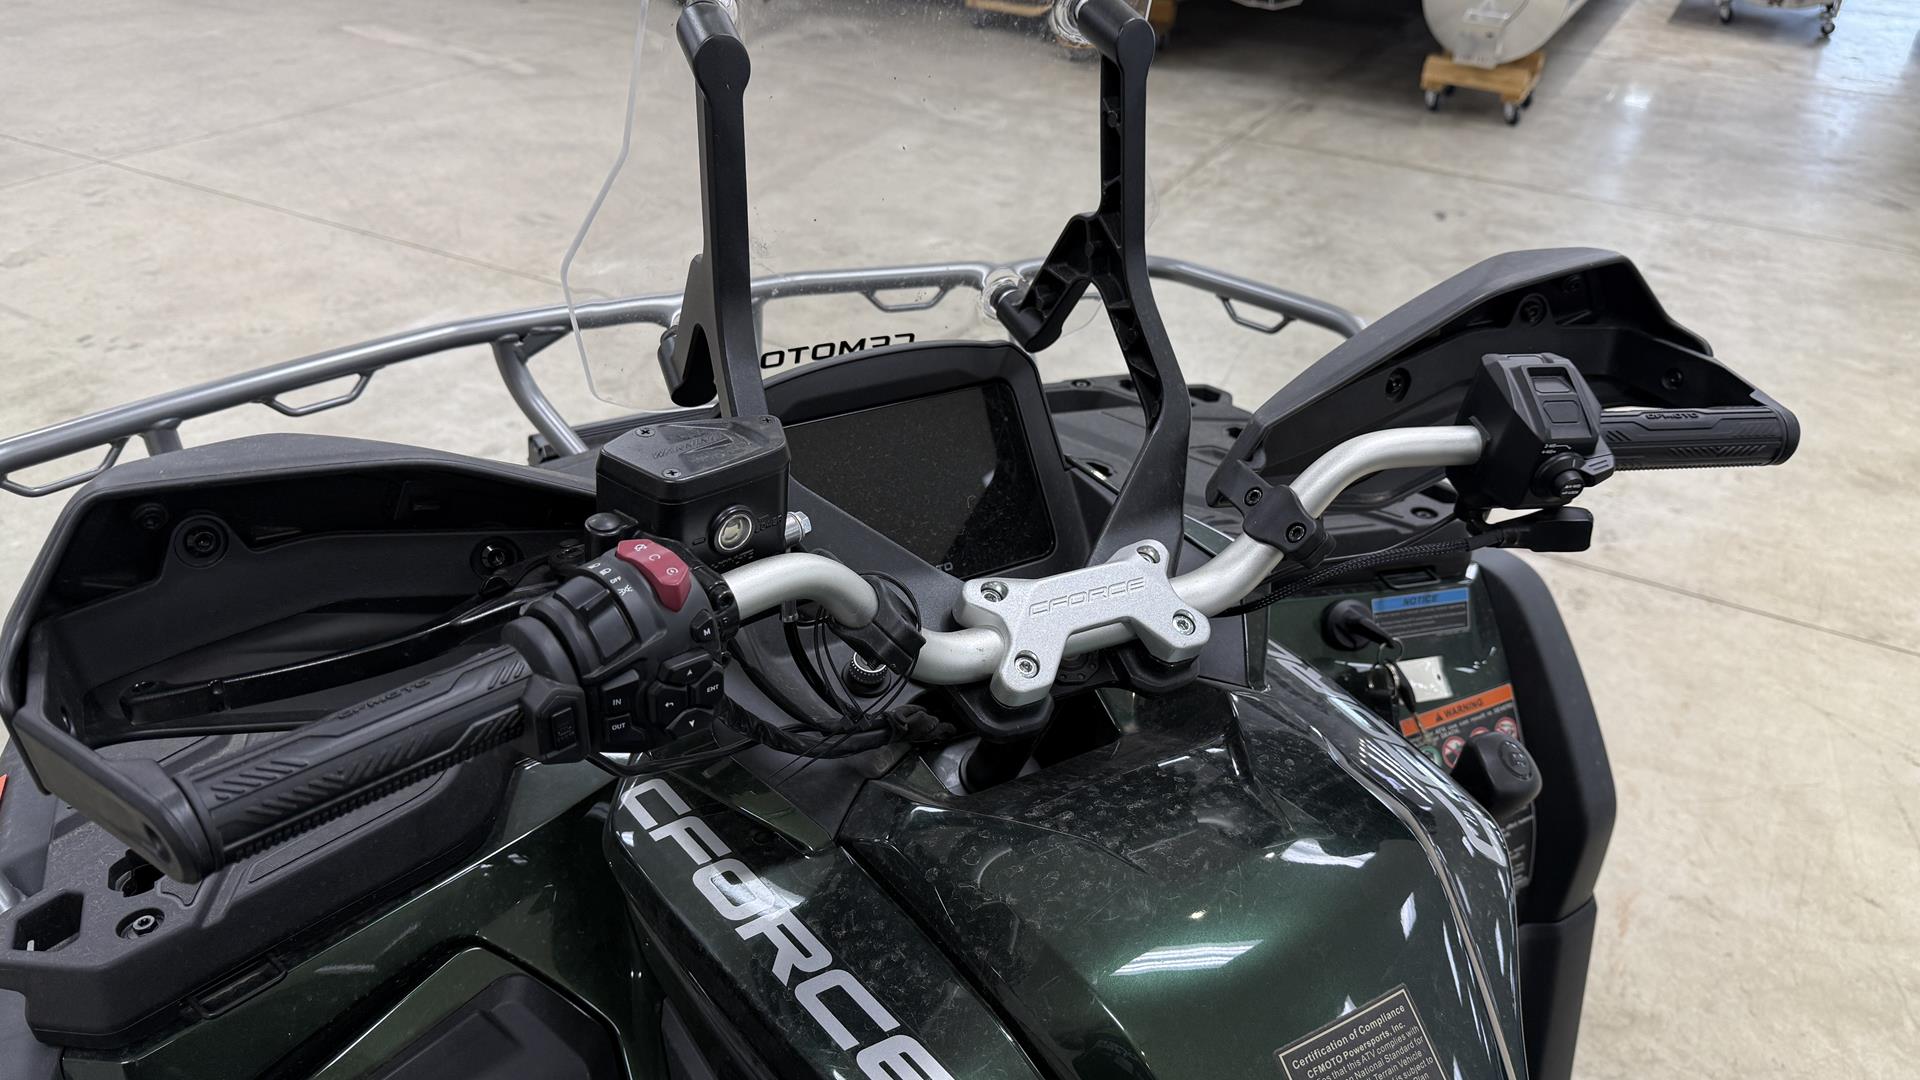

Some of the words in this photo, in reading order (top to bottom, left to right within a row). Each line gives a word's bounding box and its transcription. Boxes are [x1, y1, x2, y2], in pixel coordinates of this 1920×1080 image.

[610, 576, 622, 585] OFF
[1029, 576, 1144, 616] CFORCE
[1403, 594, 1439, 606] NOTICE
[703, 627, 711, 636] M
[706, 684, 720, 694] ENT
[612, 698, 622, 706] IN
[1446, 698, 1483, 716] WARNING
[611, 722, 626, 731] OUT
[1292, 1036, 1348, 1070] Certification
[1349, 1028, 1359, 1041] of
[1358, 1005, 1406, 1036] Compliance
[1307, 1054, 1343, 1079] CFMOTO
[1343, 1030, 1393, 1061] Powersports,
[1391, 1022, 1406, 1033] Inc.
[1331, 1065, 1348, 1080] that
[1347, 1059, 1362, 1071] this
[1361, 1048, 1376, 1063] ATV
[1376, 1033, 1406, 1054] complies
[1405, 1025, 1420, 1038] with
[1354, 1057, 1385, 1080] National
[1384, 1040, 1415, 1063] Standard
[1414, 1036, 1424, 1046] for
[1373, 1064, 1399, 1080] Terrain
[1397, 1050, 1423, 1067] Vehicle
[1402, 1059, 1428, 1079] subject
[1425, 1056, 1434, 1066] to
